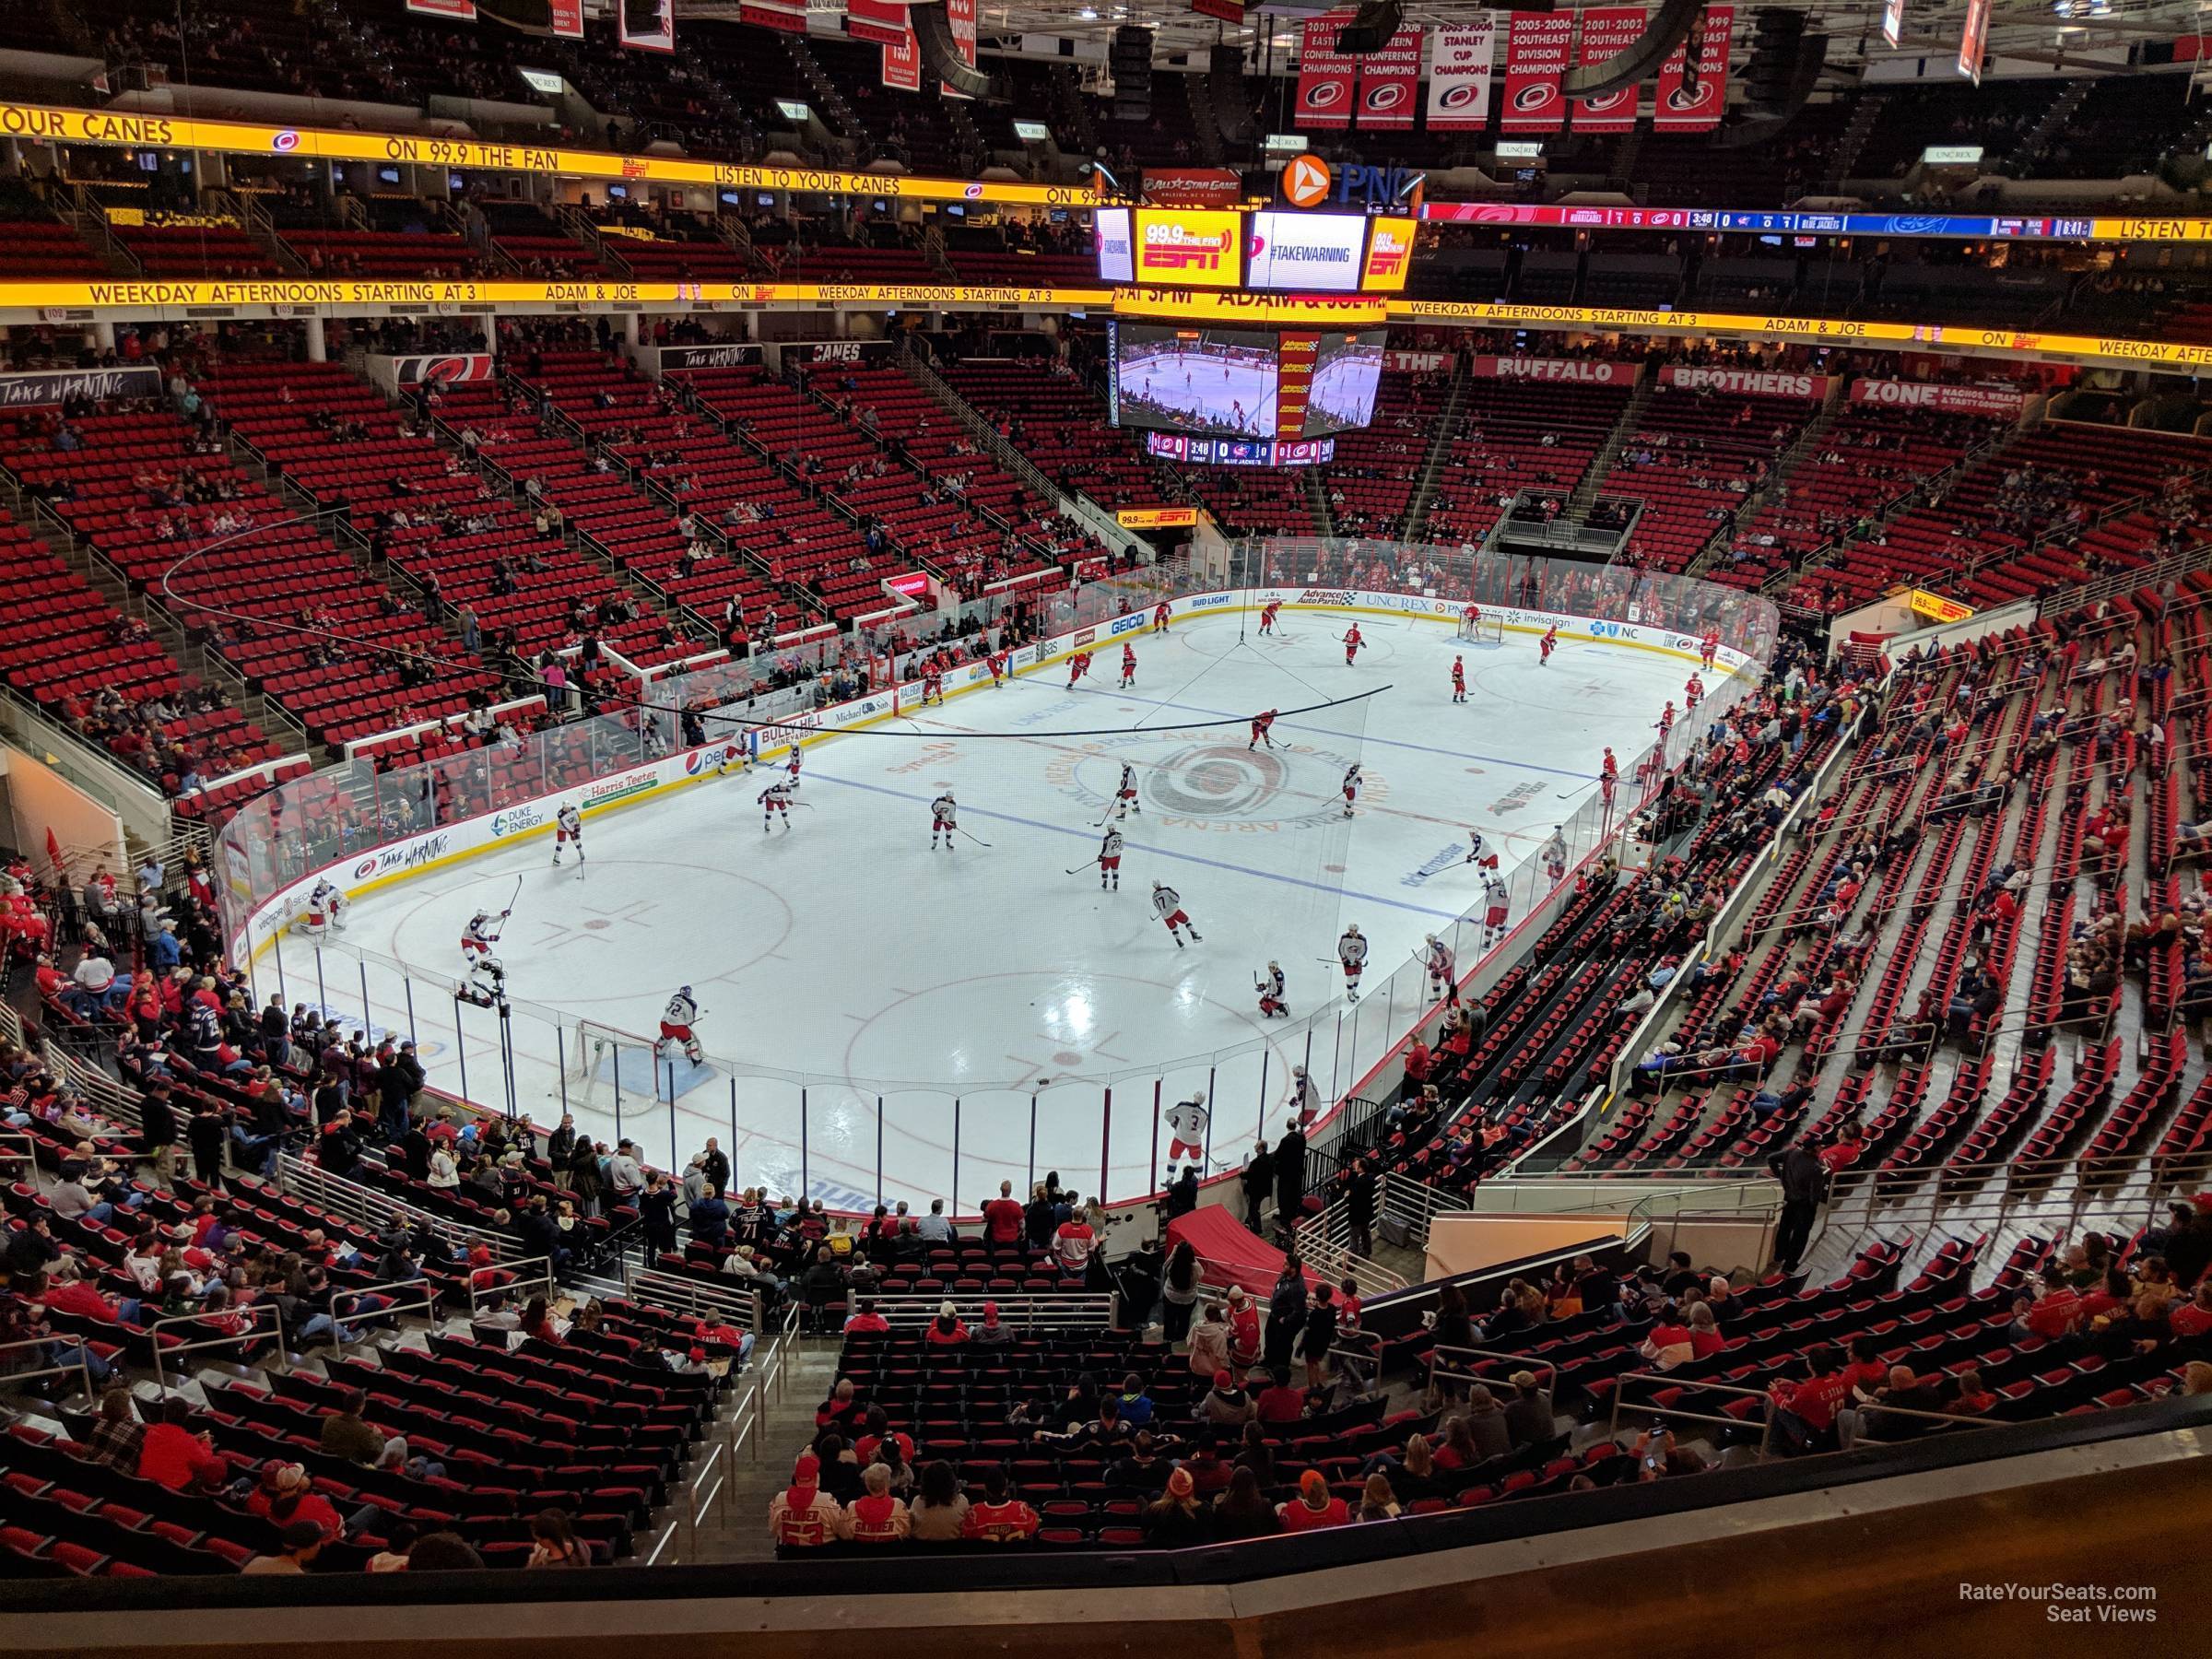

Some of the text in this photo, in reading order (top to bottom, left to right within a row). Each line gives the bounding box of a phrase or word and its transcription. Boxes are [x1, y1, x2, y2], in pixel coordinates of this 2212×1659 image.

[1514, 19, 1571, 29] 2005-2006
[1585, 20, 1642, 29] 2001-2002
[1443, 36, 1485, 46] STANLEY
[1512, 34, 1570, 44] SOUTHEAST
[1305, 51, 1353, 60] CONFERENCE
[1366, 52, 1417, 61] CONFERENCE
[1453, 51, 1472, 61] CUP
[1517, 50, 1561, 59] DIVISION
[1302, 64, 1352, 74] CHAMPIONS
[1365, 65, 1416, 76] CHAMPIONS
[1435, 65, 1488, 76] CHAMPIONS
[1510, 64, 1565, 74] CHAMPIONS
[544, 78, 559, 88] REX
[83, 114, 172, 145] CANES
[386, 138, 559, 170] ON 99.9 THE FAN
[714, 166, 900, 194] LISTEN TO YOUR CANES
[1182, 179, 1238, 190] STAR GAME
[1339, 163, 1410, 205] PNC
[1047, 187, 1072, 204] ON
[1571, 213, 1603, 223] HURRICANES
[1633, 212, 1681, 225] 0 0
[1692, 213, 1712, 224] 3:48
[1723, 213, 1730, 226] 0
[1802, 220, 1840, 229] BLUE JACKETS
[1147, 224, 1184, 244] 99.9
[2063, 220, 2081, 235] 6:41
[2120, 221, 2186, 238] LISTEN
[1376, 232, 1392, 252] 99.9
[1144, 244, 1220, 269] ESPN
[1271, 245, 1349, 263] #TAKEWARNING
[1369, 252, 1403, 275] ESPN
[89, 284, 476, 303] WEEKDAY AFTERNOONS STARTING AT 3
[546, 285, 638, 300] ADAM & JOE
[733, 286, 749, 300] ON
[818, 286, 1053, 302] WEEKDAY AFTERNOONS STARTING AT 3
[48, 308, 64, 318] 102
[278, 304, 291, 313] 103
[441, 303, 452, 312] 104
[1410, 302, 1697, 326] WEEKDAY AFTERNOONS STARTING AT 3
[1764, 319, 1865, 335] ADAM & JOE
[1983, 332, 2006, 346] ON
[813, 345, 860, 362] CANES
[2100, 340, 2170, 359] WEEKDAY
[686, 348, 746, 368] TAKE WARNING
[1395, 353, 1444, 371] THE
[1497, 359, 1613, 382] BUFFALO
[1, 373, 127, 404] TAKE WARNING
[1674, 369, 1812, 395] BROTHERS
[1864, 382, 1938, 406] ZONE
[1942, 388, 2022, 403] NACHOS, WRAPS
[1950, 397, 1977, 406] TASTY
[1175, 439, 1182, 453] 0
[1191, 442, 1208, 455] 3:48
[1219, 442, 1266, 457] 0 0
[1279, 447, 1285, 456] 0
[1310, 443, 1316, 456] 0
[1159, 511, 1192, 522] ESPN
[1193, 595, 1230, 607] BUD LIGHT
[1303, 590, 1342, 599] Advance
[1367, 594, 1429, 611] UNC REX
[1112, 613, 1145, 634] GEICO
[1524, 613, 1571, 629] invisalign
[1075, 633, 1094, 645] Lenovo
[1621, 628, 1639, 639] NC
[1664, 639, 1677, 649] LIVE
[900, 683, 921, 700] RALEIGH
[836, 700, 888, 724] Michael Son
[762, 722, 798, 743] BULLY
[773, 731, 814, 747] VINEYARDS
[591, 771, 657, 798] Harris Teeter
[509, 806, 532, 821] DUKE
[509, 814, 544, 832] ENERGY
[379, 833, 451, 870] TAKE WARNING
[1112, 839, 1123, 850] 27
[1400, 842, 1465, 888] ticketmaster
[1154, 896, 1166, 911] 17
[259, 907, 283, 930] VECTOR
[1191, 1114, 1199, 1131] 3
[743, 1223, 757, 1239] 71
[701, 1335, 722, 1345] FAULK
[988, 1525, 1011, 1534] WARD
